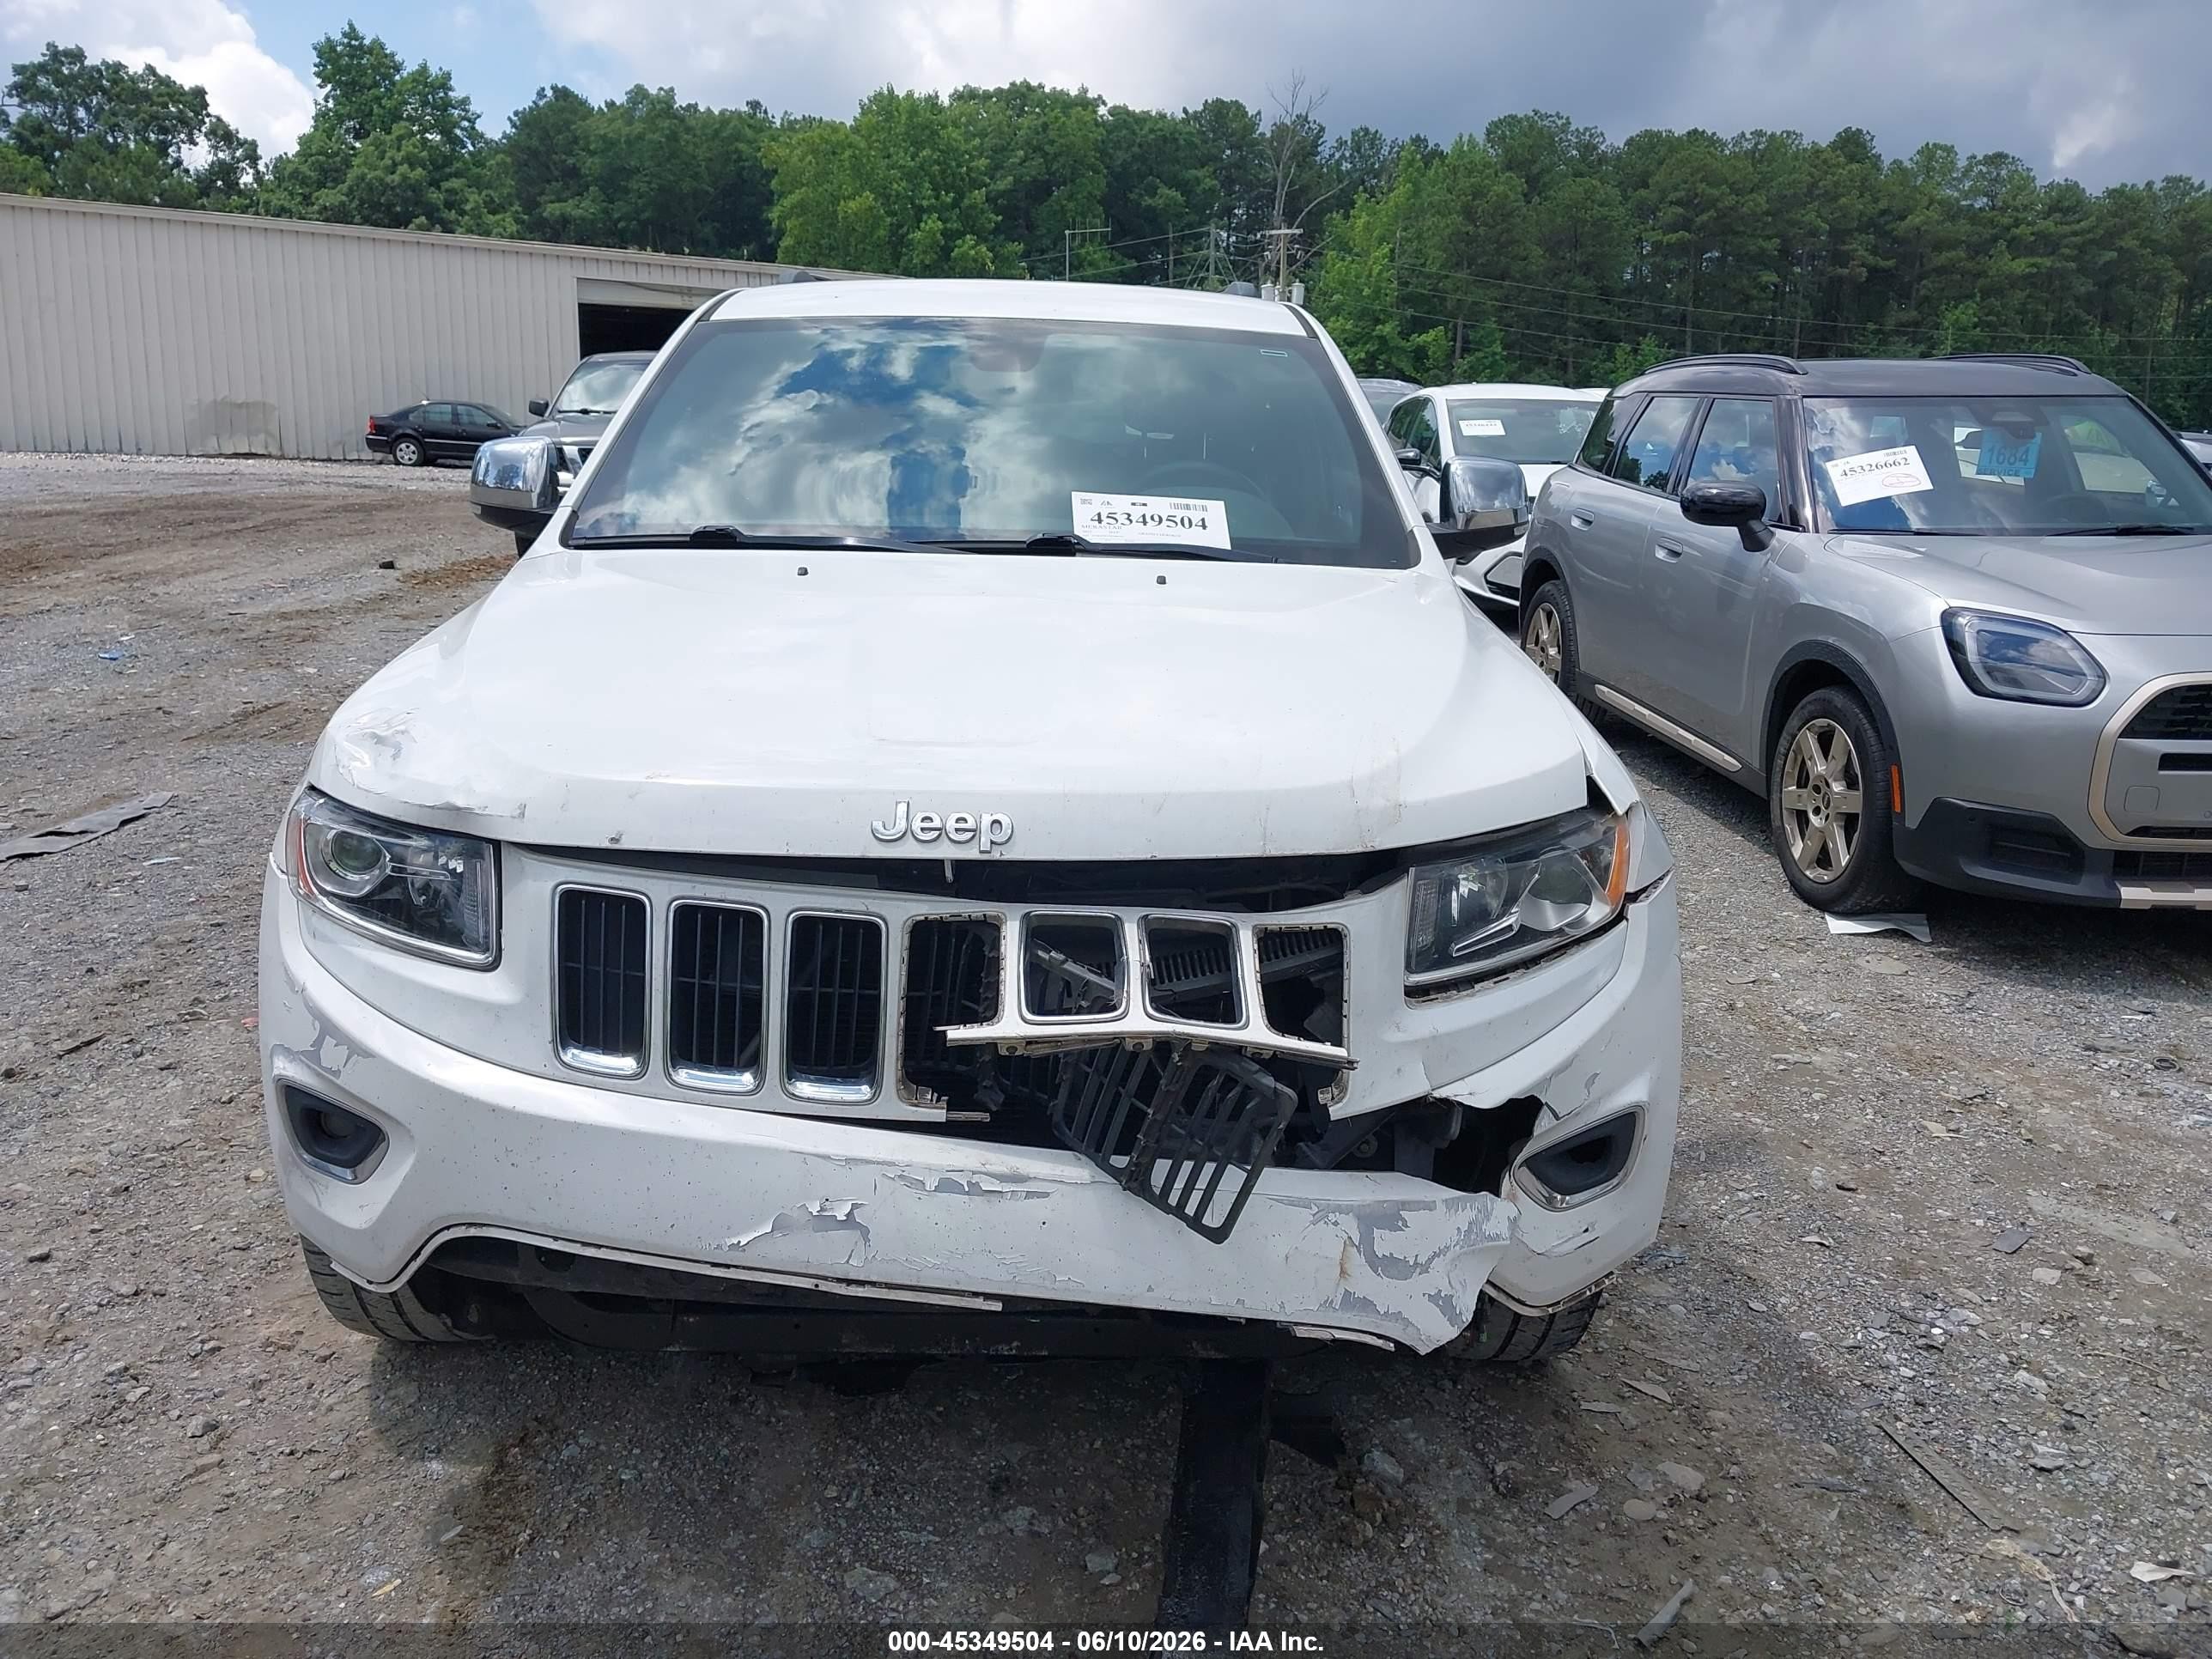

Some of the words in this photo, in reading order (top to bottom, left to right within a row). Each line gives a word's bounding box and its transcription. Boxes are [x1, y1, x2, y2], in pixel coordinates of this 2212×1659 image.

[1840, 457, 1911, 477] 45326662
[1090, 512, 1208, 531] 45349504
[871, 799, 1014, 854] Jeep
